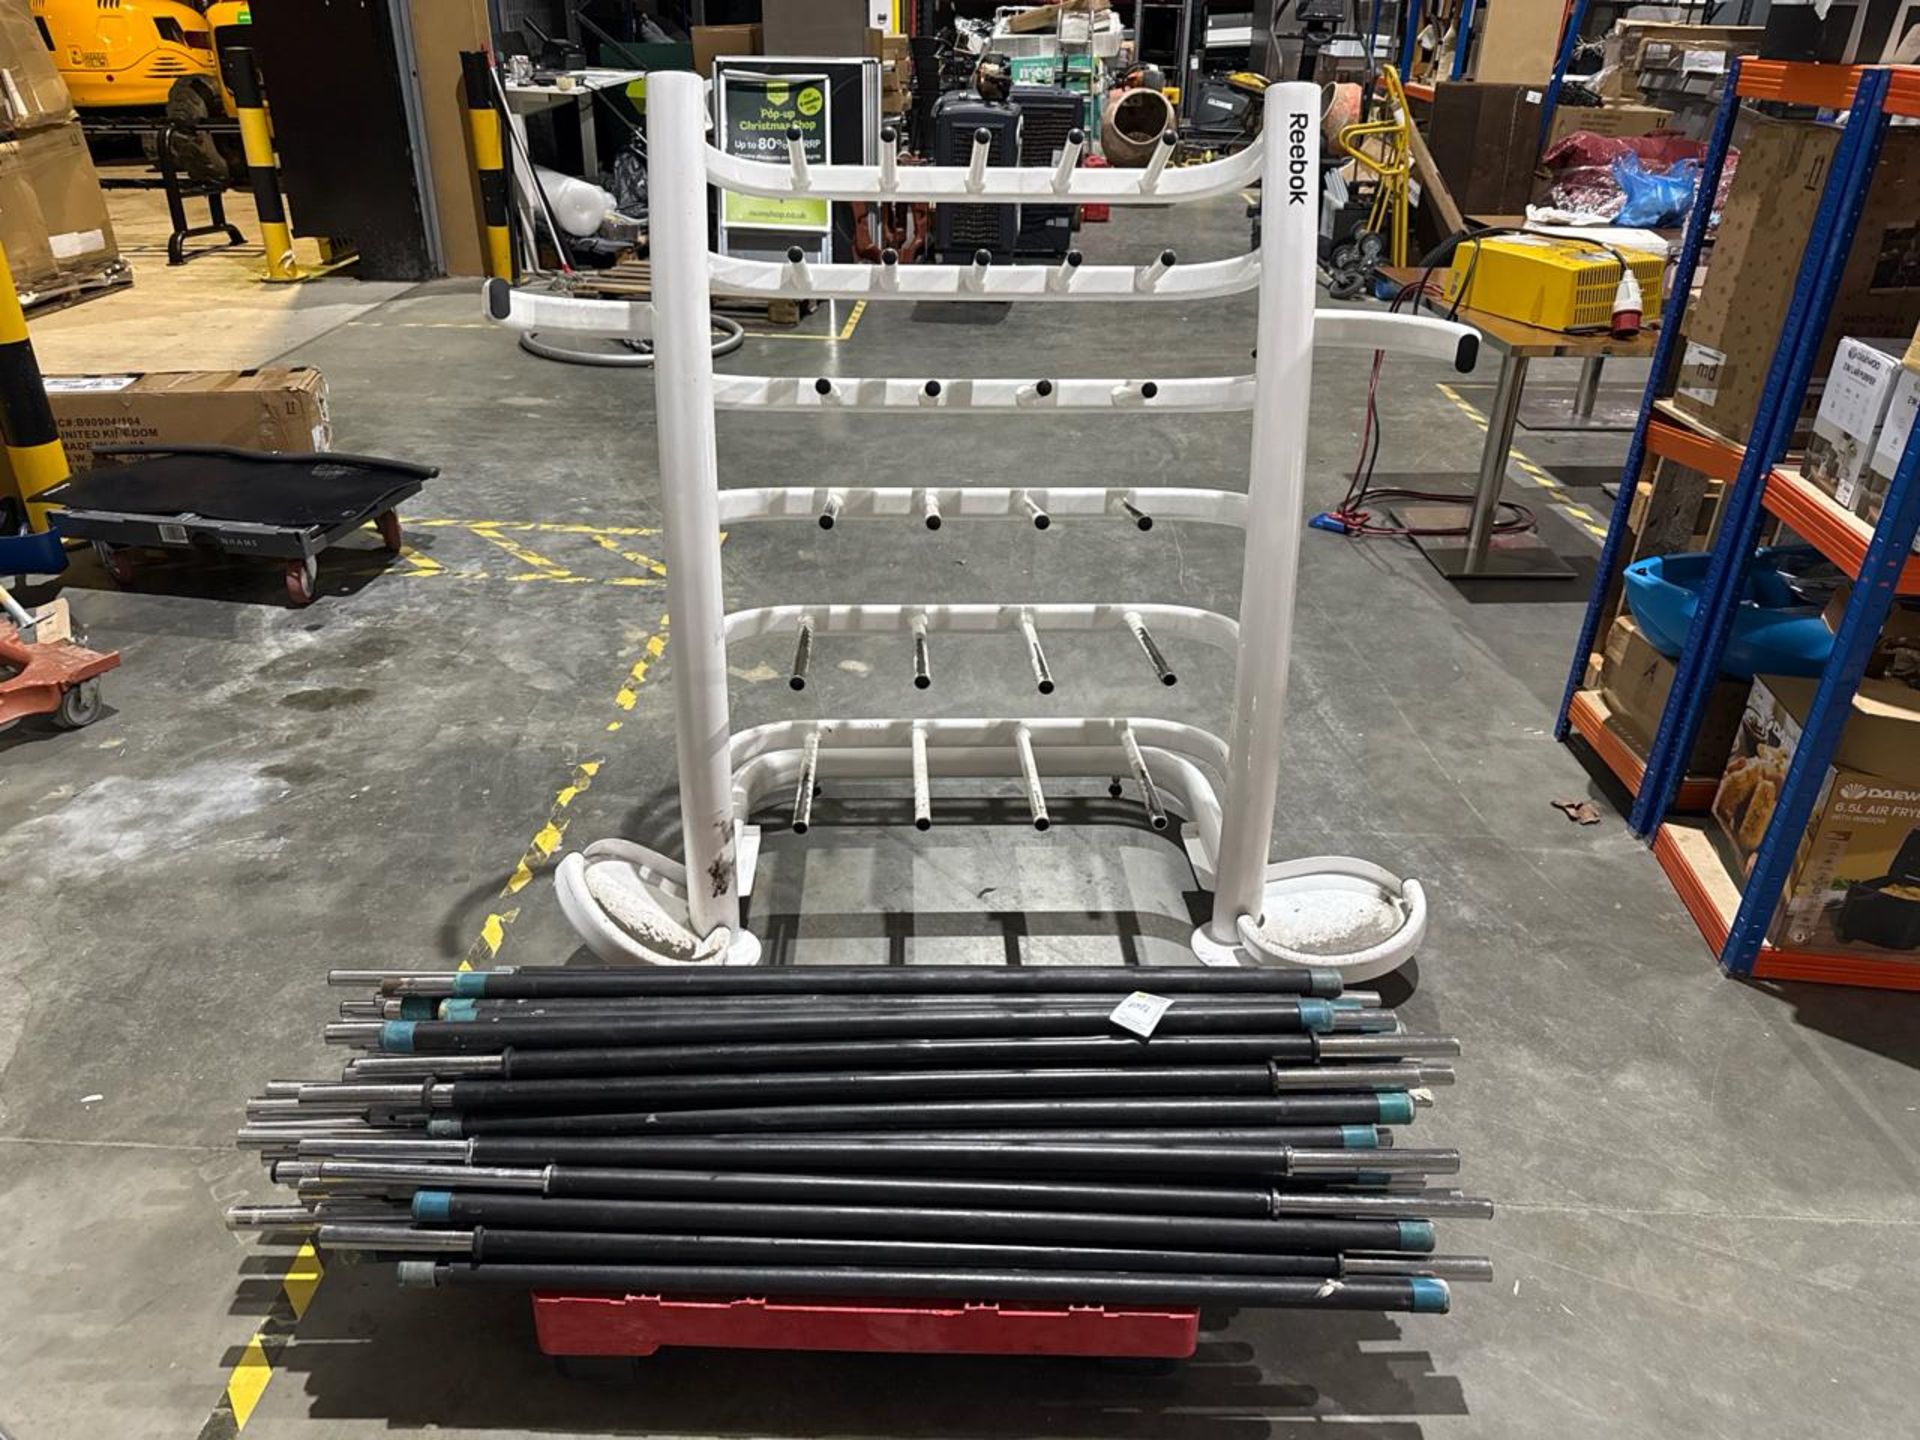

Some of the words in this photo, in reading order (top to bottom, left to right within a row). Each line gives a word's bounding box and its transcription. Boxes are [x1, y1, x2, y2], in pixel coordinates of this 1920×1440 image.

[760, 108, 796, 120] Pop-up
[734, 140, 746, 150] Up
[747, 141, 757, 149] to
[1289, 113, 1309, 206] Reebok
[1834, 802, 1863, 814] 6.5L
[1866, 804, 1889, 816] AIR
